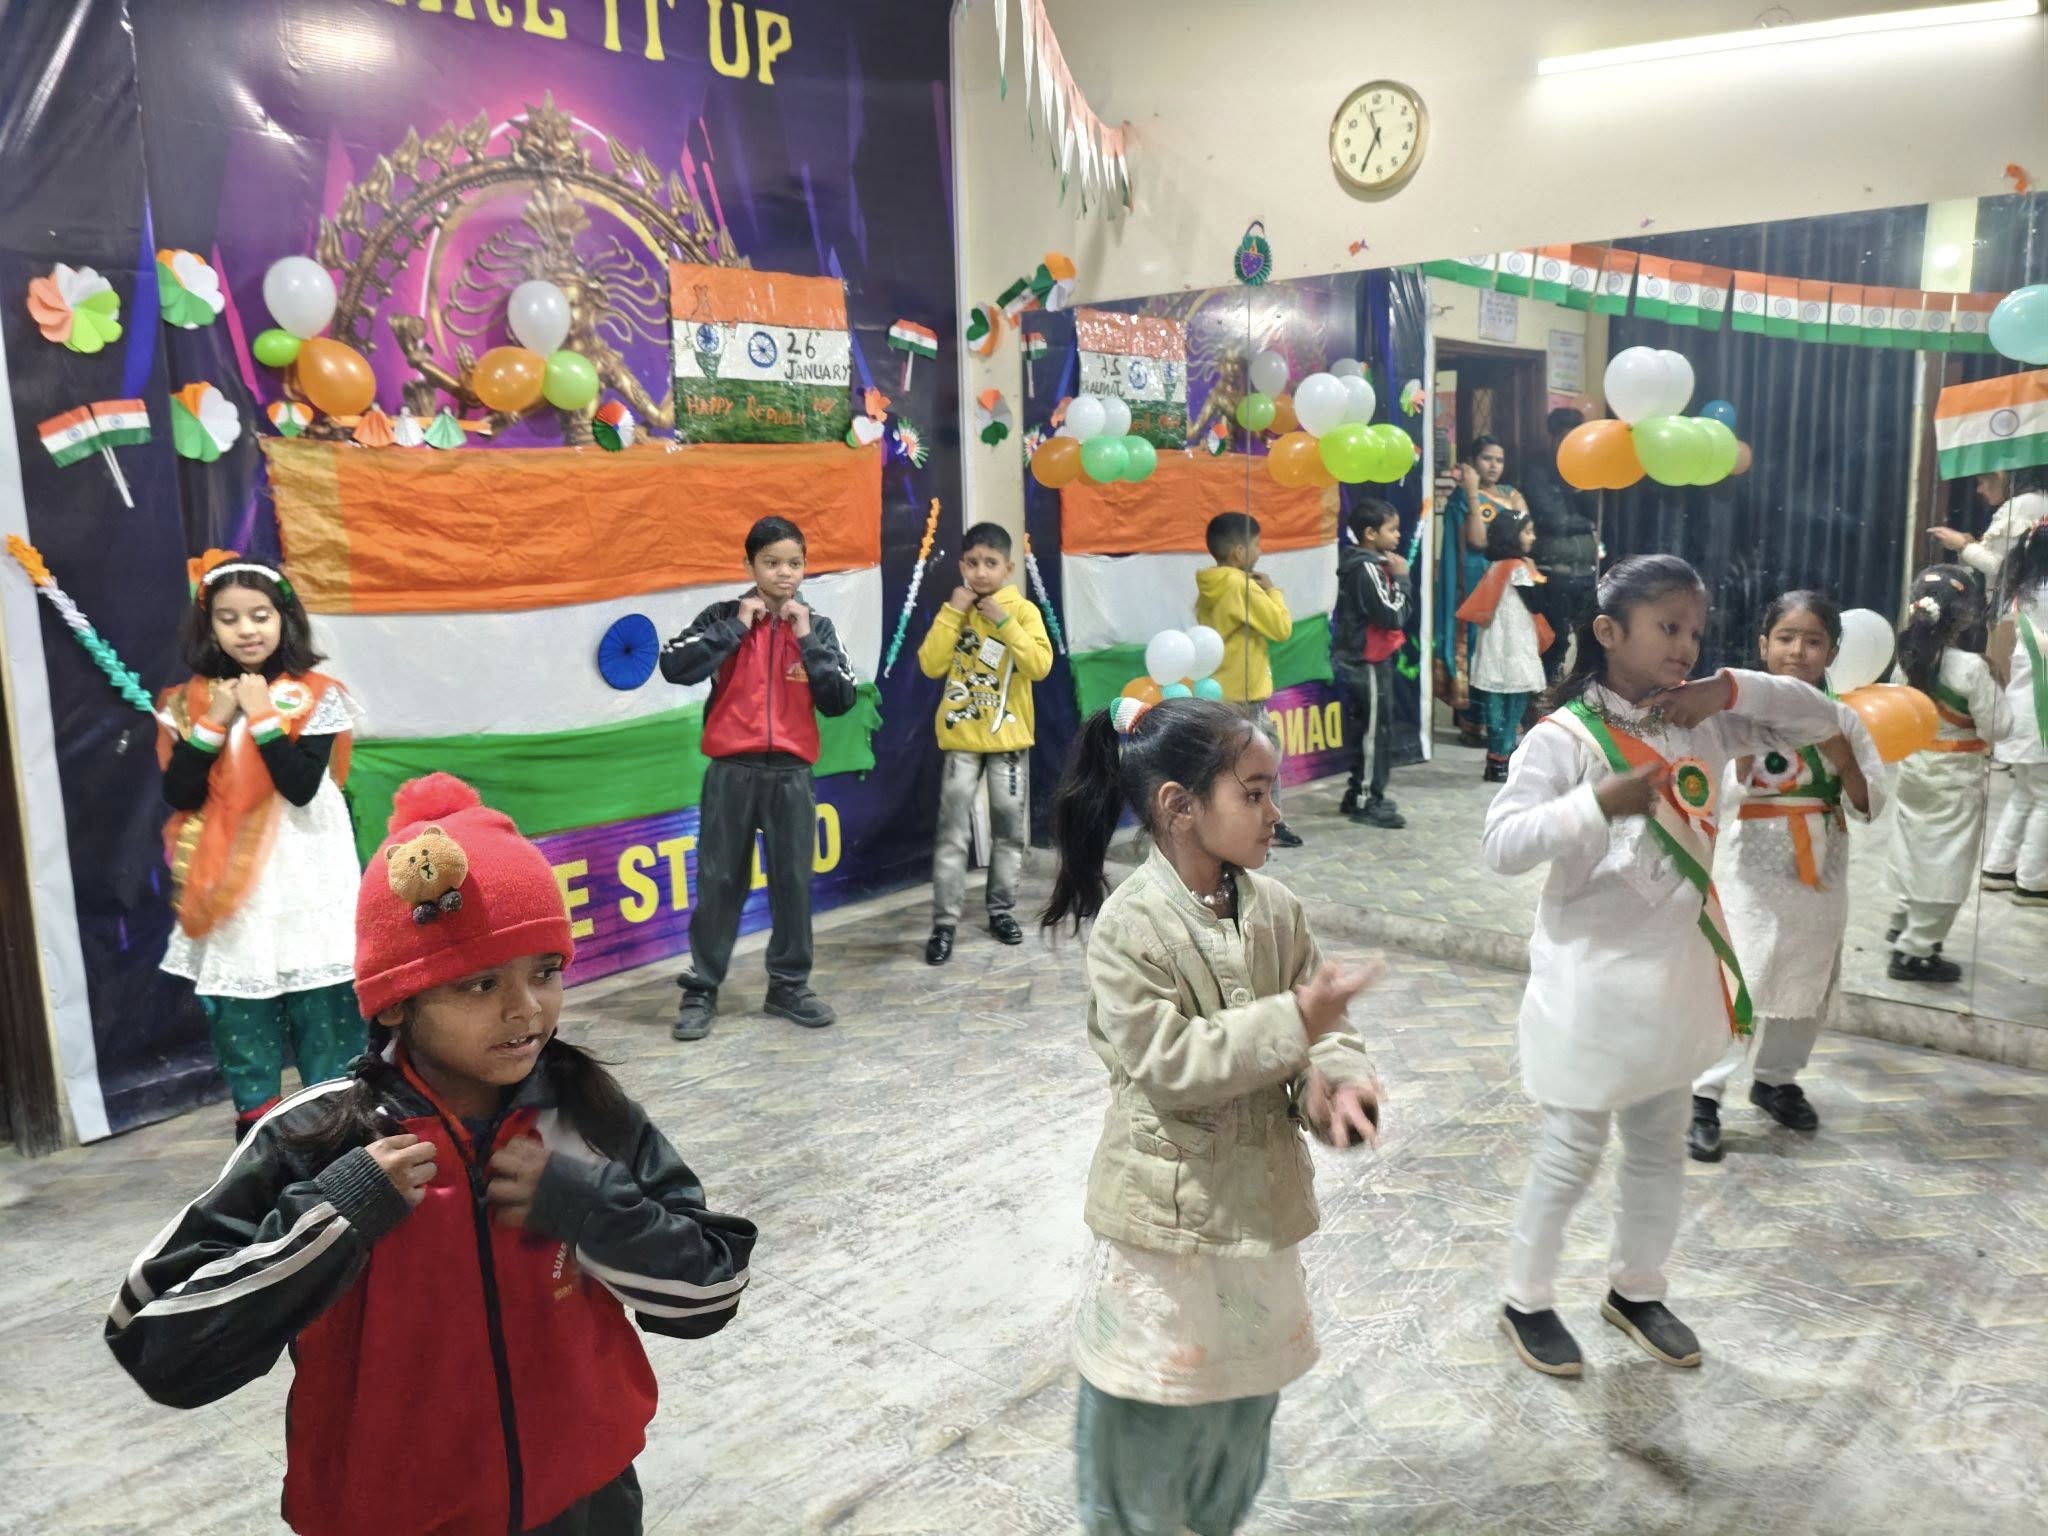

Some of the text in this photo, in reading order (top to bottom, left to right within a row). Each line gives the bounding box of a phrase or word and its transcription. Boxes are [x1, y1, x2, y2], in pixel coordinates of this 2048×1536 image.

[707, 0, 792, 85] UP
[784, 360, 852, 381] JANUARY
[617, 803, 841, 923] STO
